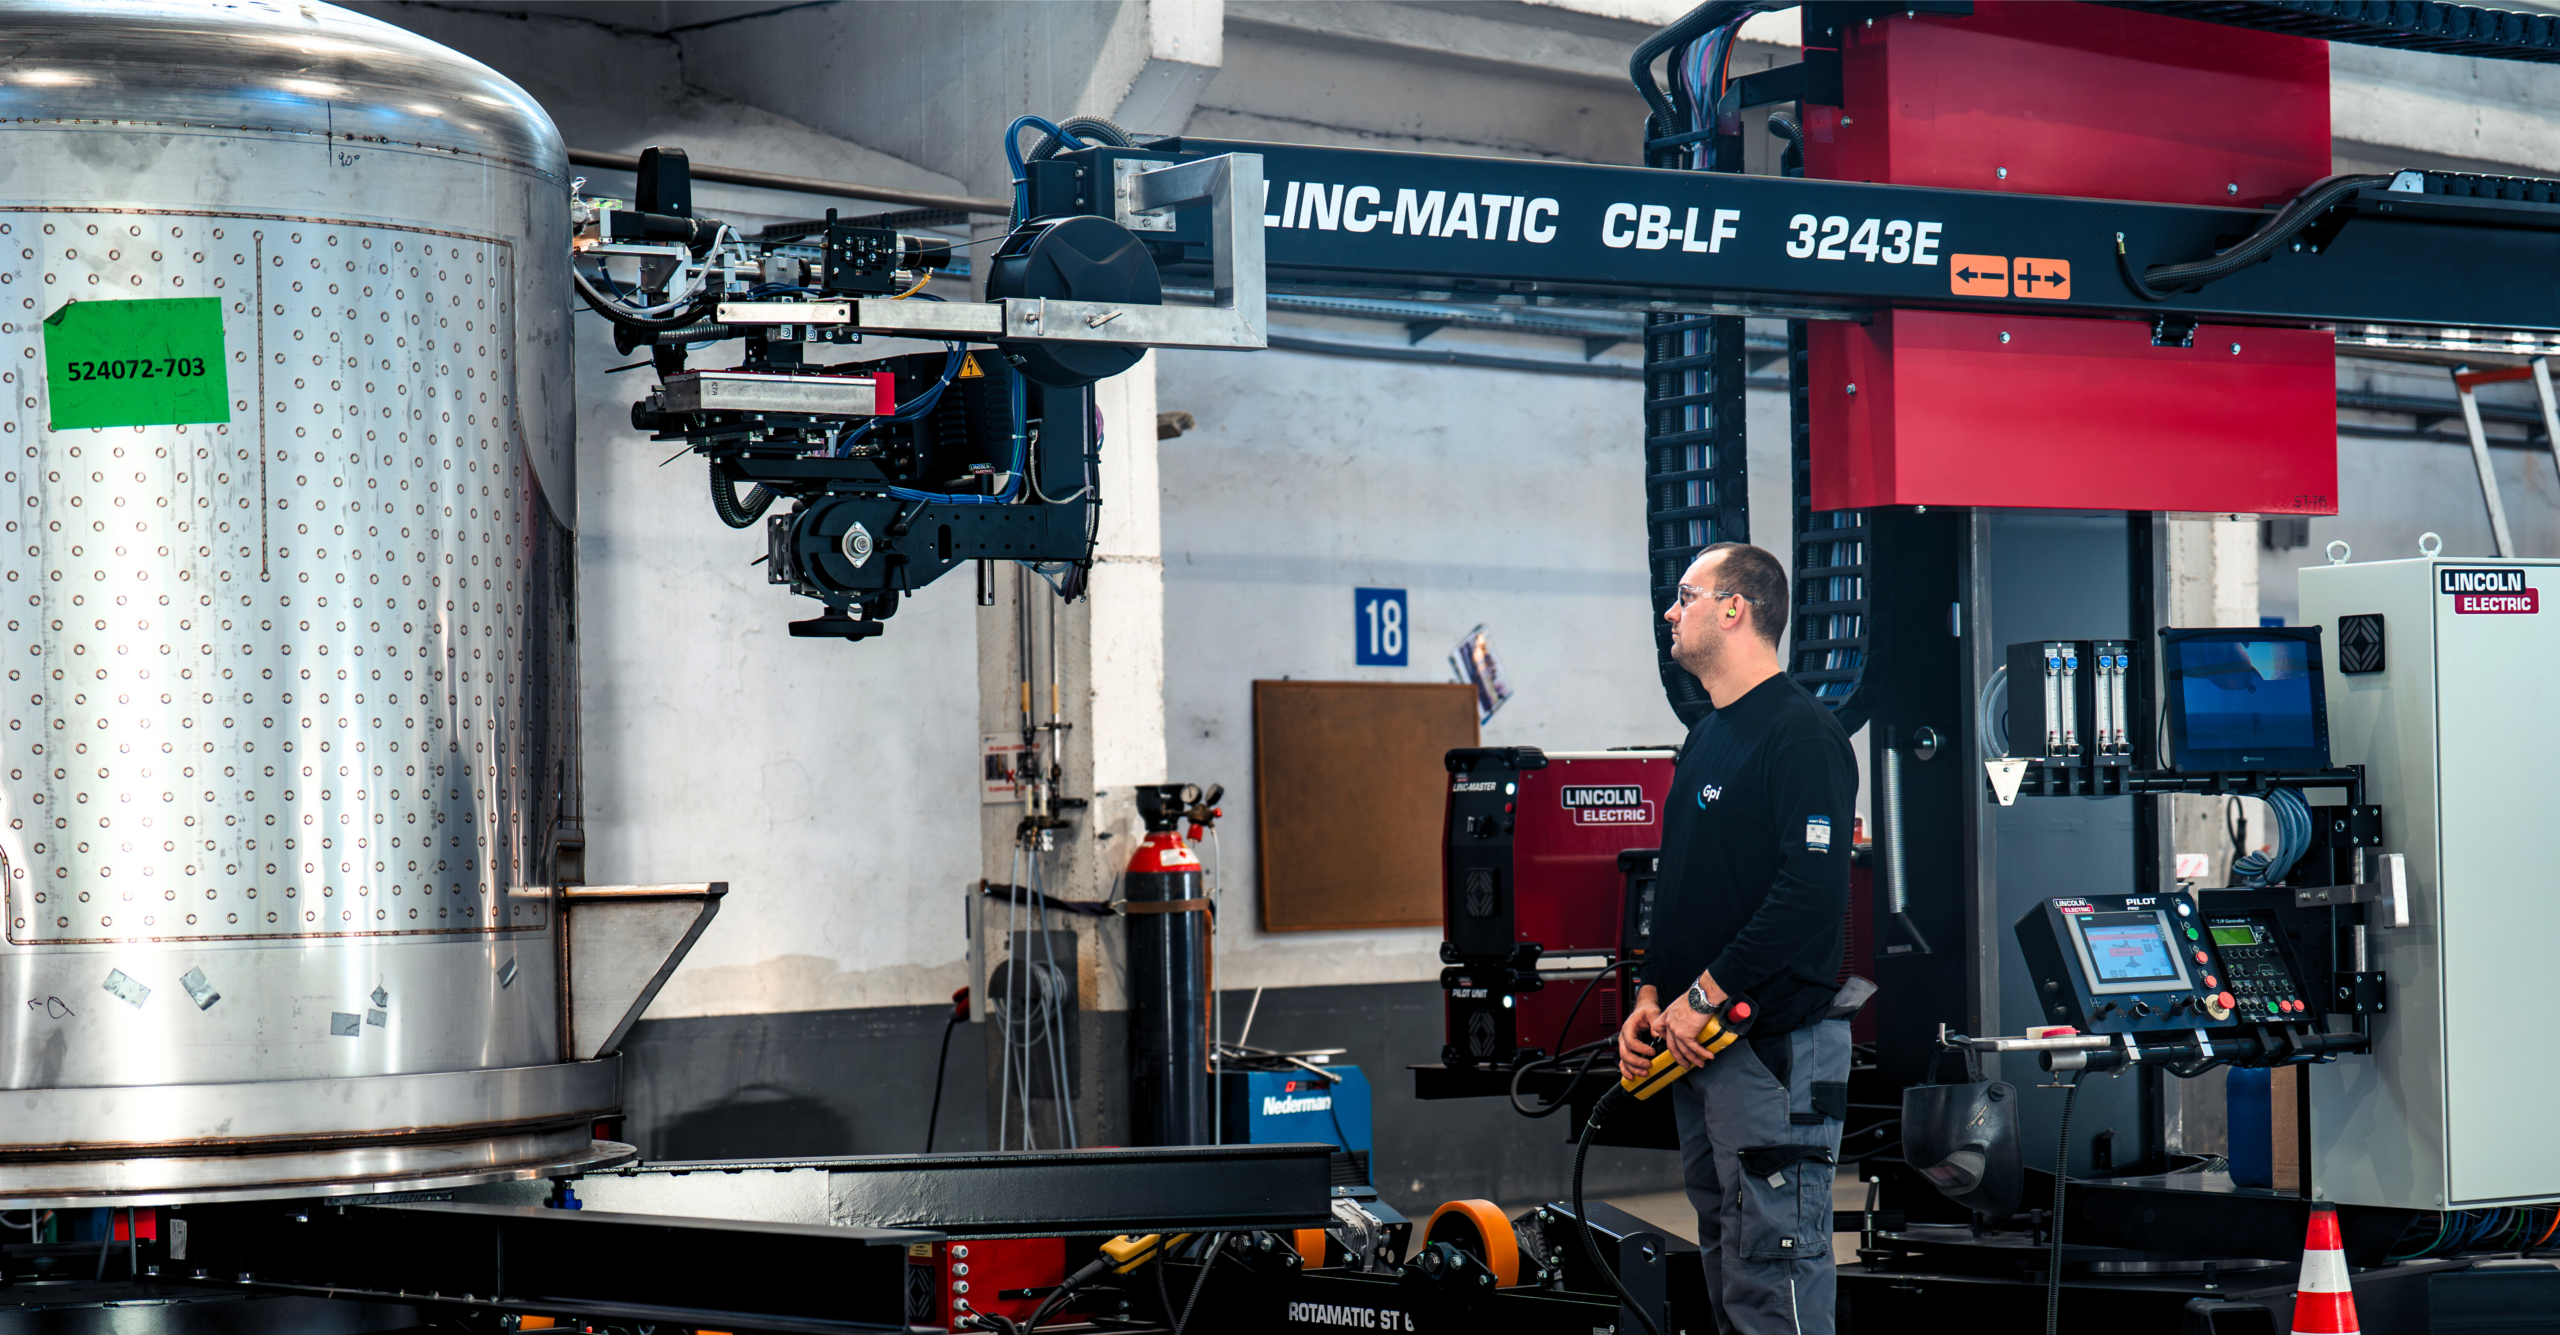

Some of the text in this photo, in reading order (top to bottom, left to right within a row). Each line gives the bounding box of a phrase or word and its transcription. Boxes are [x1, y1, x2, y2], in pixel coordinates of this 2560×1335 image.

[1263, 180, 1944, 266] LINC-MATIC CB-LF 3243E
[68, 357, 206, 382] 524072-703
[711, 381, 719, 396] RTA
[2444, 573, 2522, 592] LINCOLN
[2463, 597, 2532, 612] ELECTRIC
[1365, 599, 1403, 657] 18
[1452, 781, 1497, 792] LINC-MASTER
[1702, 784, 1723, 803] Gpi
[1566, 789, 1637, 806] LINCOLN
[1583, 809, 1646, 821] ELECTRIC
[2125, 897, 2157, 906] PILOT
[1452, 988, 1488, 999] PILOT UNIT
[1263, 1095, 1332, 1116] Nederman
[1289, 1301, 1375, 1328] ROTAMATIC
[1380, 1309, 1400, 1331] ST
